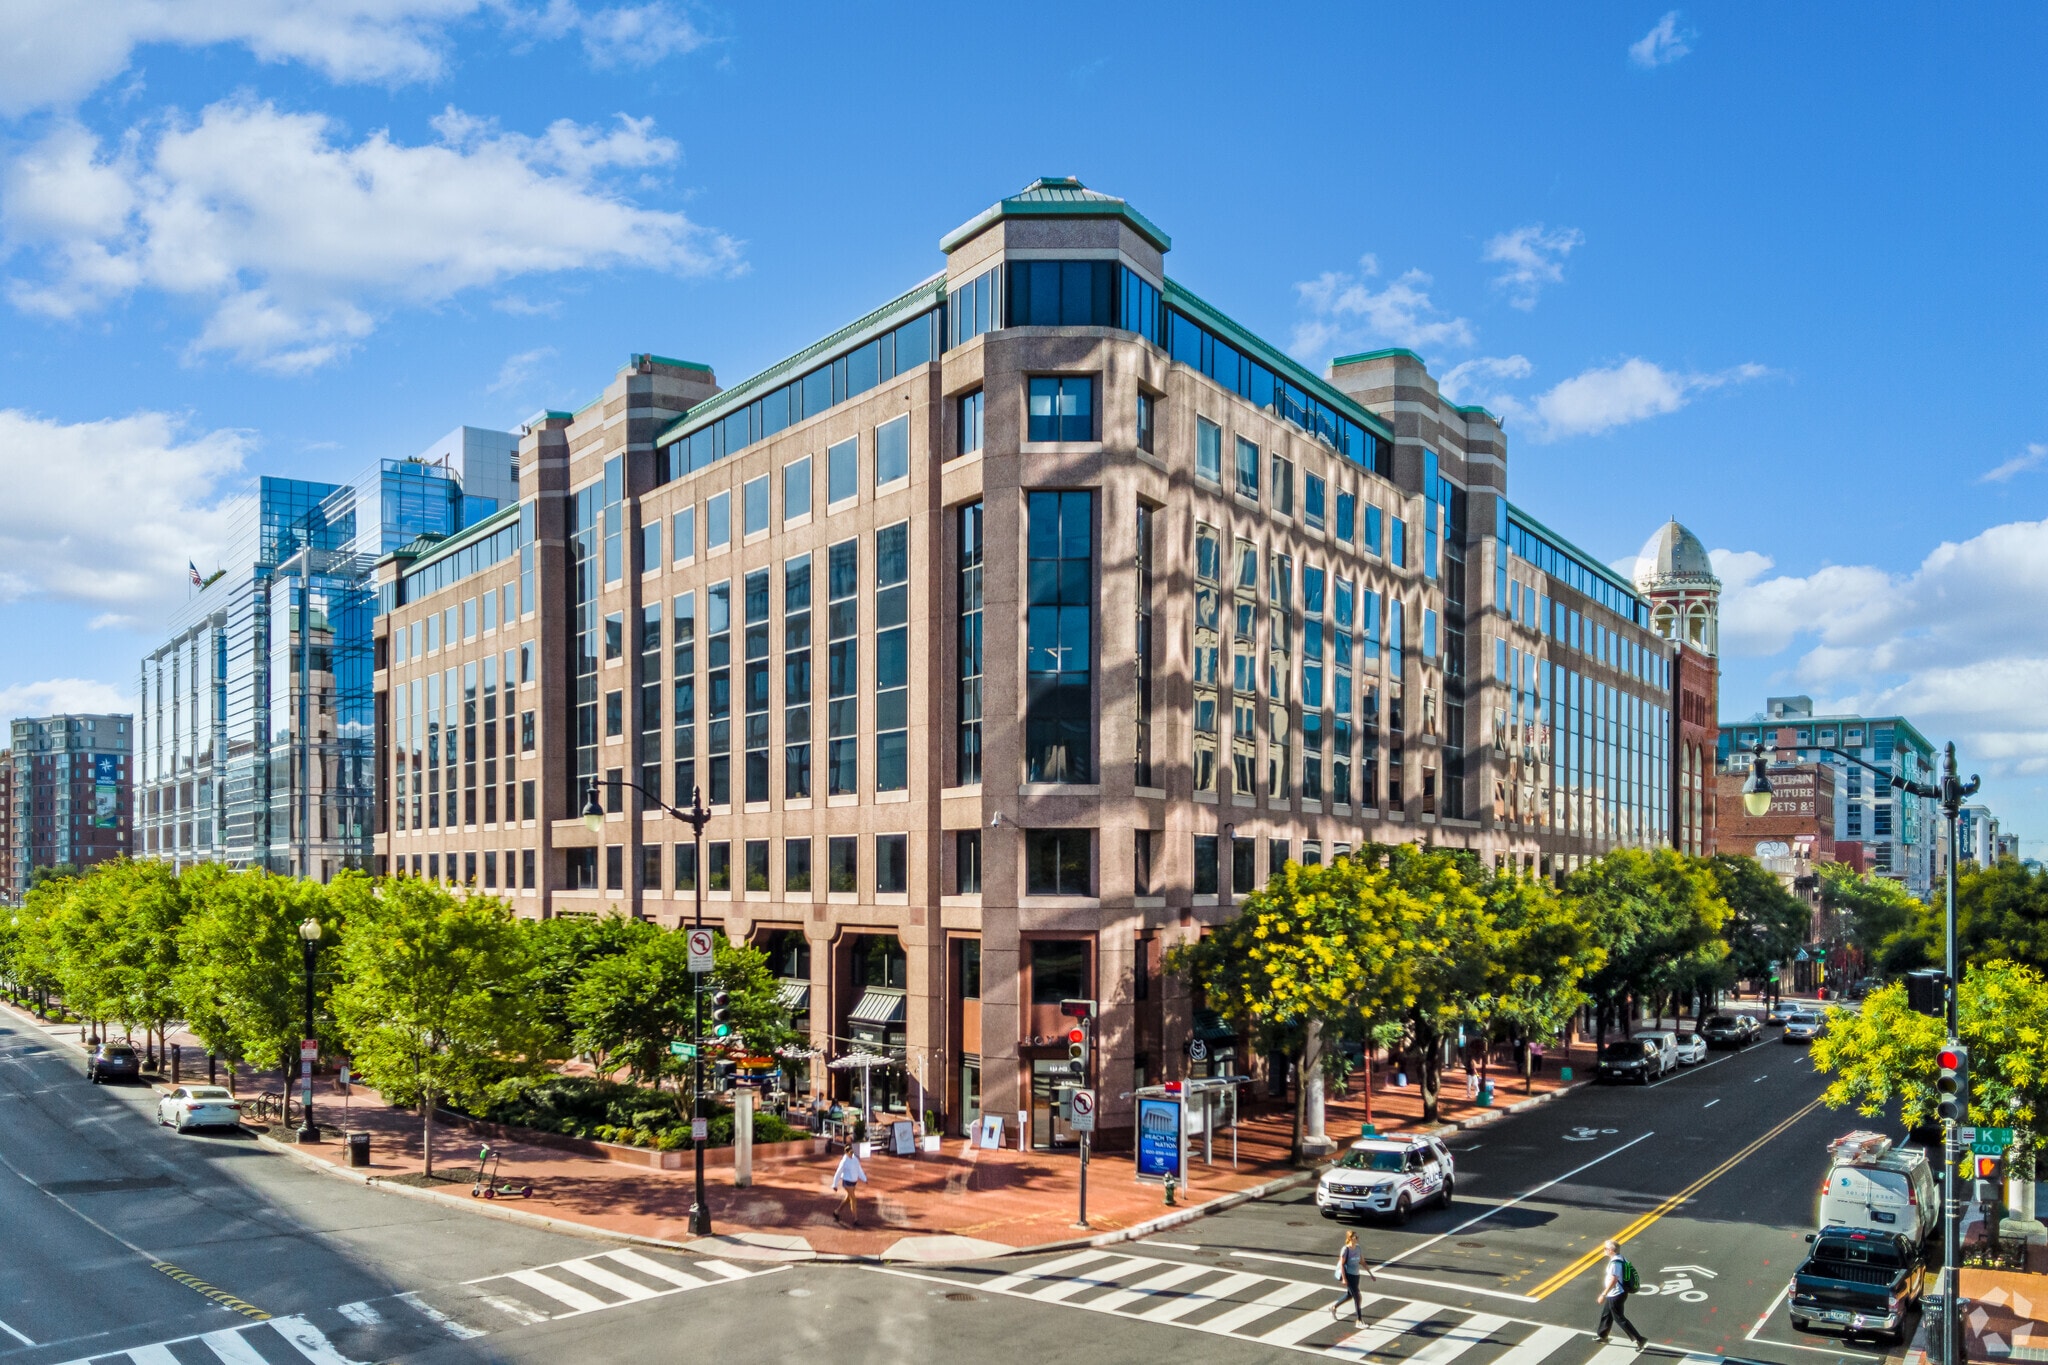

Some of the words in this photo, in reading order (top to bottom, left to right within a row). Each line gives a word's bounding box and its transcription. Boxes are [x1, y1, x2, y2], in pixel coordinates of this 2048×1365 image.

[1771, 788, 1814, 798] NITURE
[1769, 801, 1797, 812] PETS
[1145, 1132, 1164, 1141] REACH
[1982, 1130, 1994, 1142] K
[1154, 1141, 1177, 1150] NATION
[1973, 1143, 2002, 1154] 700
